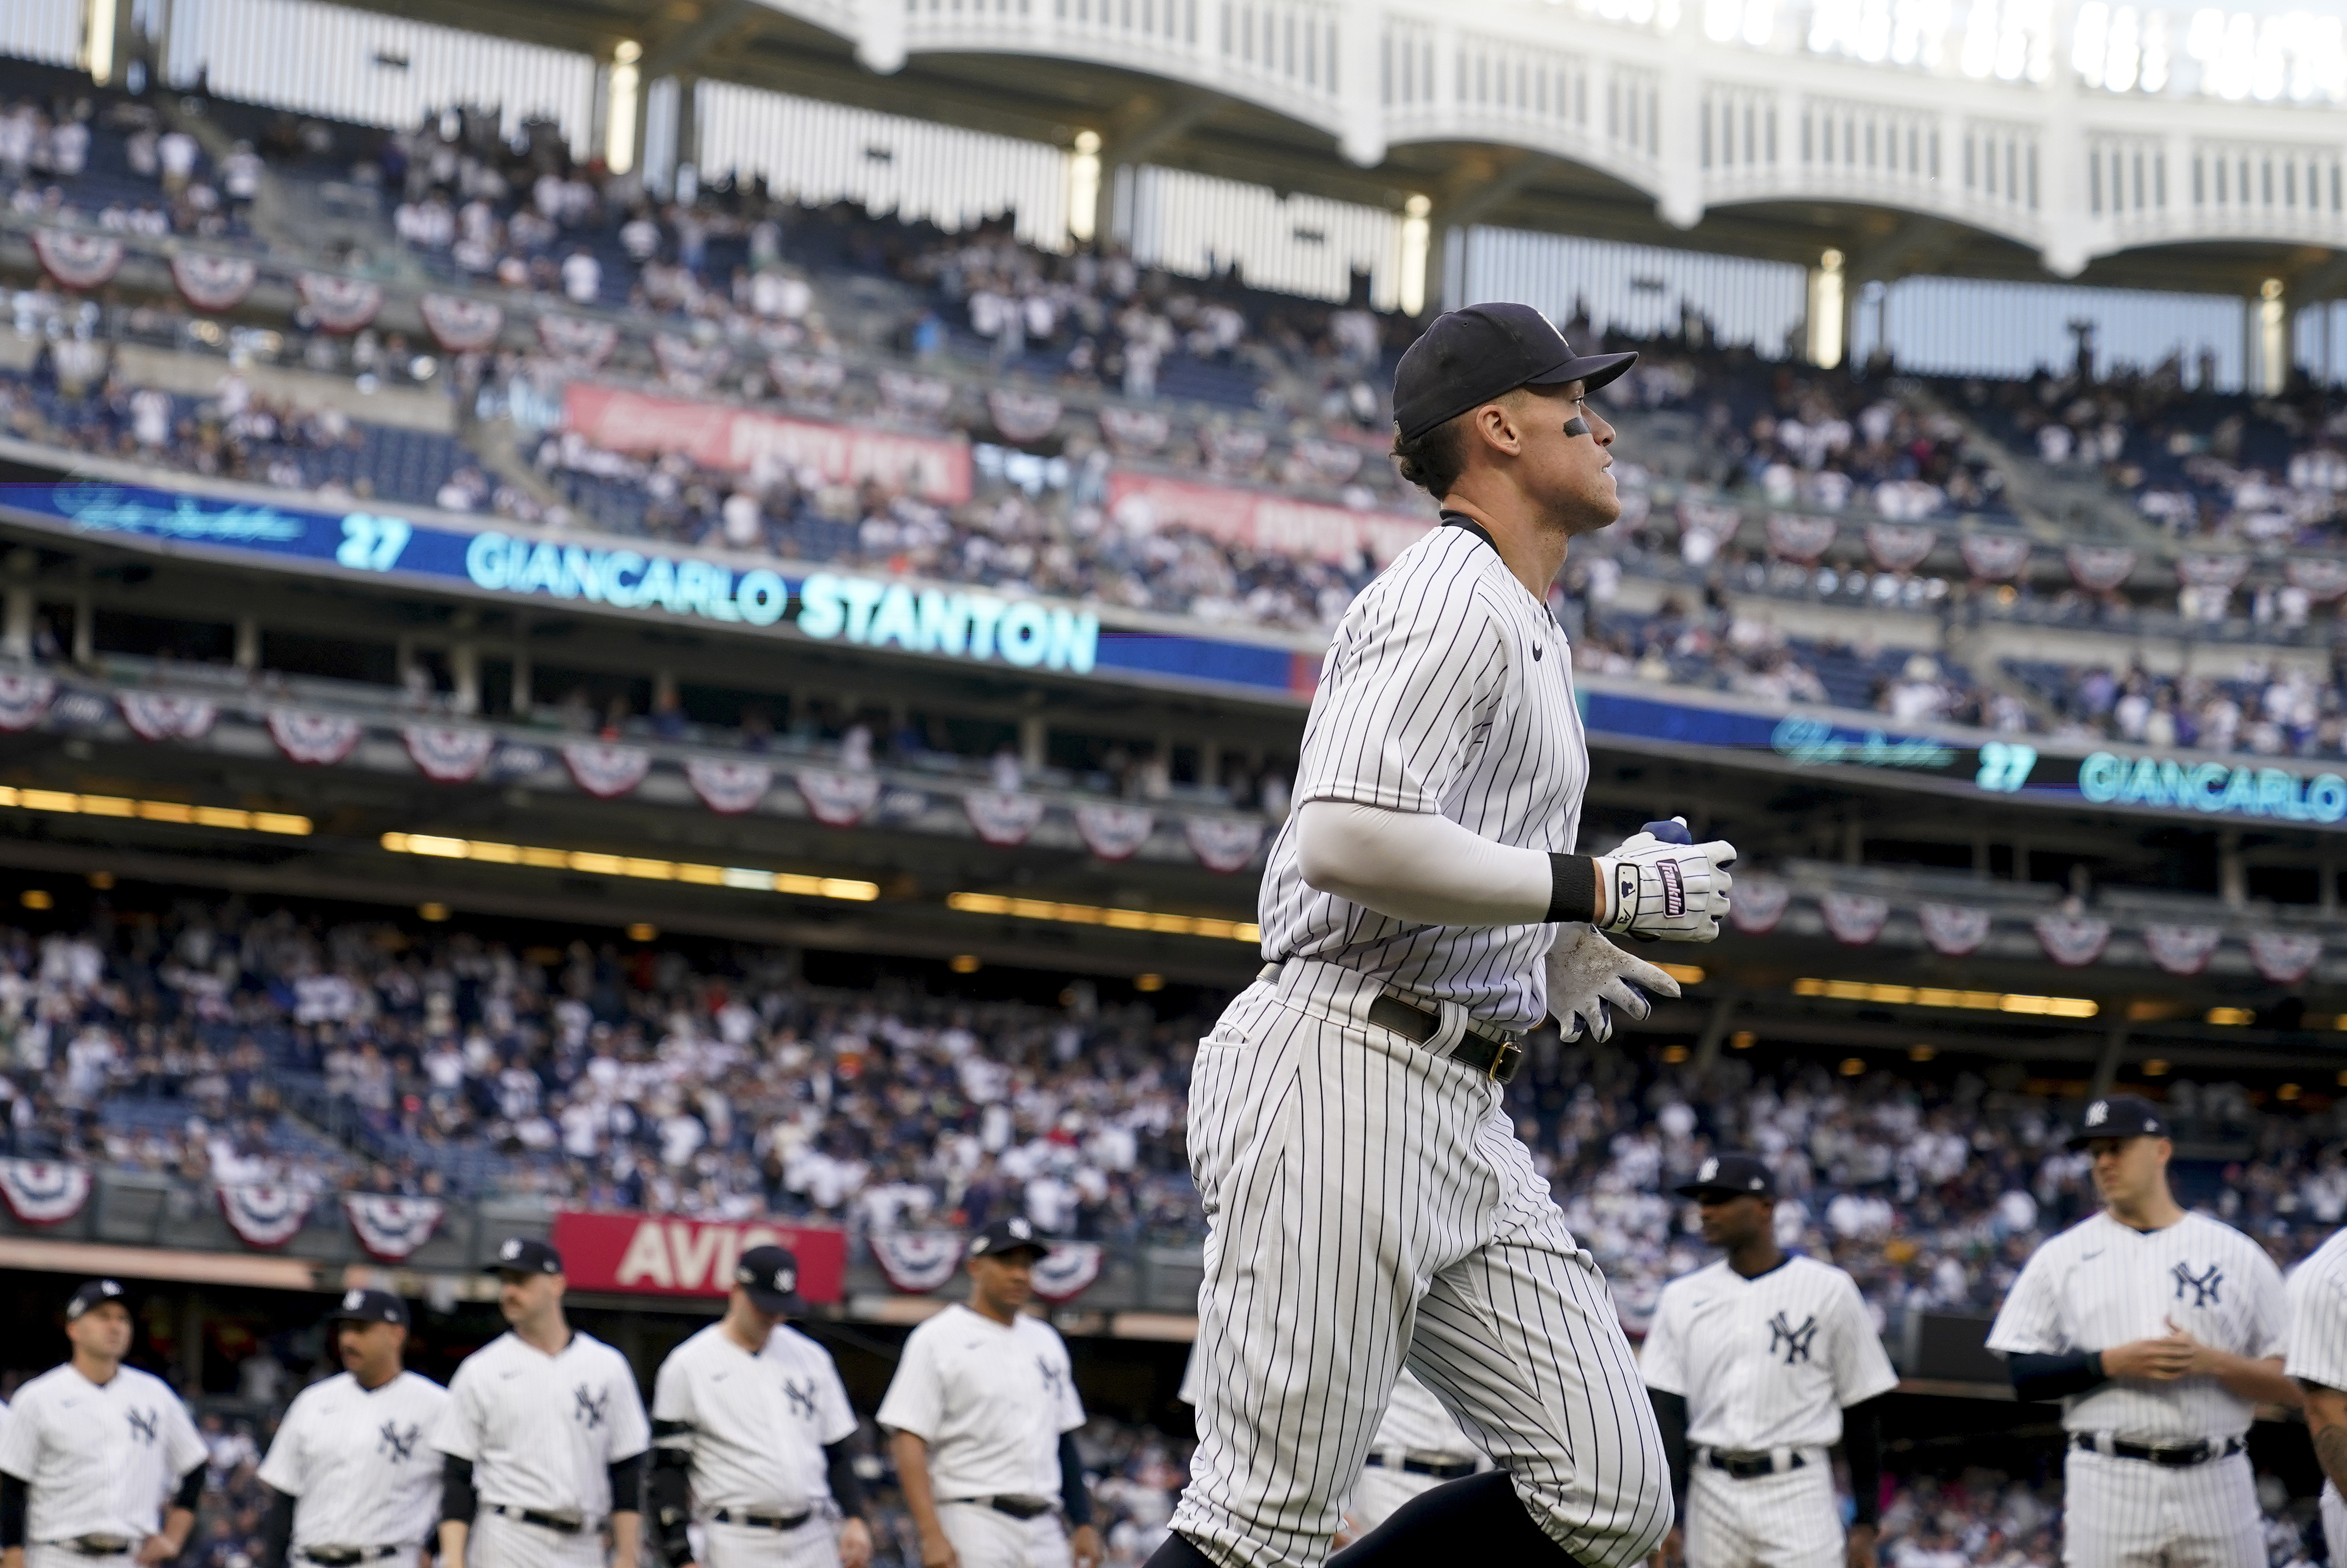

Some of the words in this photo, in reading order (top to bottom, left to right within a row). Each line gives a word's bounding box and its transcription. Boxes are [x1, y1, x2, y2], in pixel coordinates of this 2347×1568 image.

[336, 512, 413, 572] 27
[466, 530, 787, 626] GIANCARLO
[797, 572, 1099, 674] STANTON
[1976, 741, 2037, 793] 27
[2078, 751, 2347, 823] GIANCARLO
[1656, 861, 1682, 915] Franklin
[2170, 1261, 2223, 1308] NY
[1767, 1310, 1818, 1365] NY
